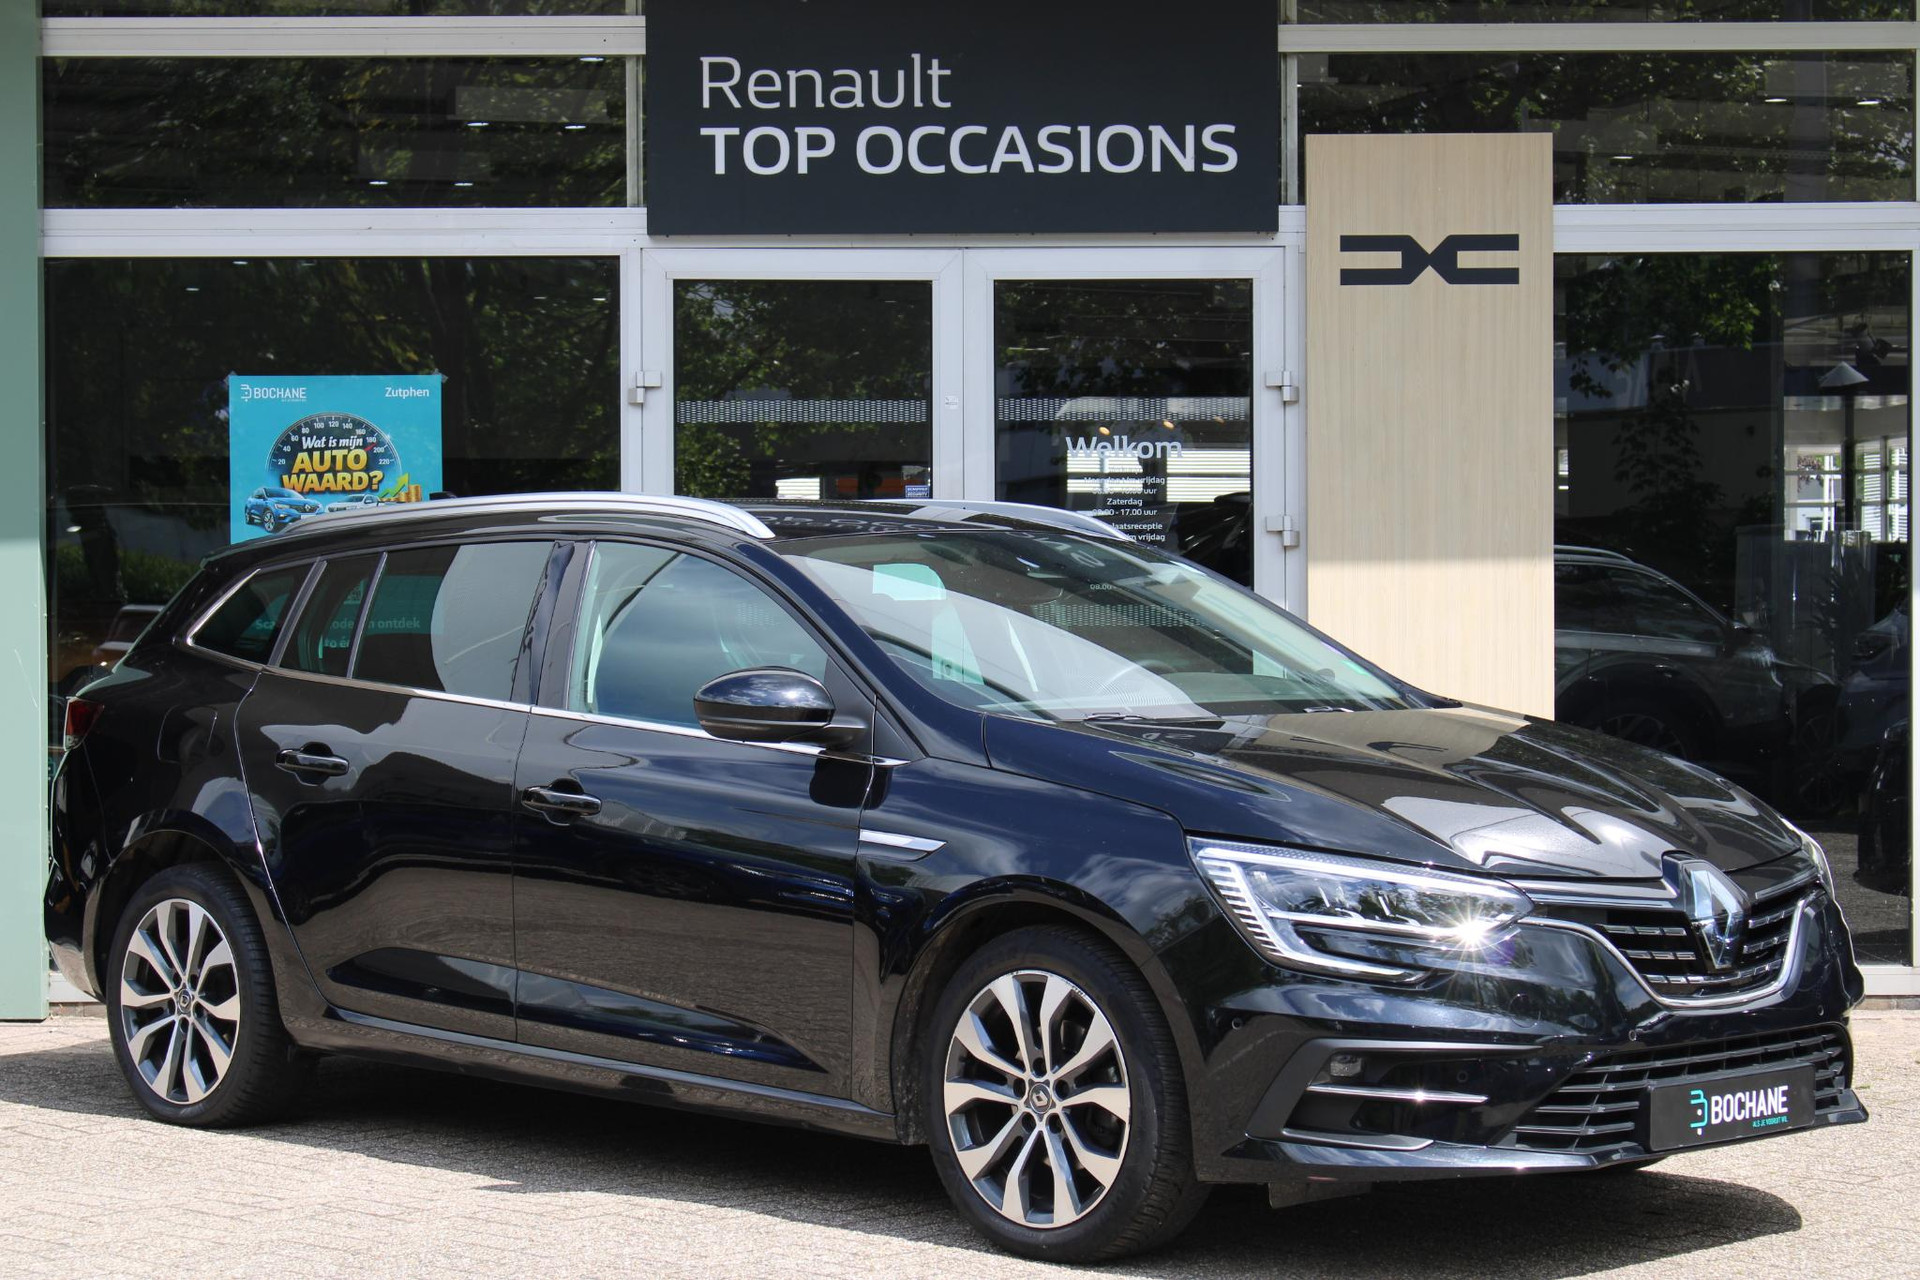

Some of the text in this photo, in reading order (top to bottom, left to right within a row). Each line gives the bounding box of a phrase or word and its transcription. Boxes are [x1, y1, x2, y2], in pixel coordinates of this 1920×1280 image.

[699, 53, 952, 109] Renault
[699, 123, 1239, 175] TOP OCCASIONS
[253, 387, 307, 399] BOCHANE
[385, 386, 430, 399] Zutphen
[342, 422, 353, 430] 140
[301, 436, 363, 450] Wat is mijn
[1065, 435, 1182, 459] Welkom
[291, 450, 368, 474] AUTO
[281, 470, 384, 493] WAARD?
[1138, 477, 1165, 485] vrijdag
[1106, 498, 1143, 506] Zaterdag
[1120, 508, 1142, 516] 17.00
[1112, 522, 1163, 531] laatsreceptie
[1138, 533, 1165, 542] vrijdag
[255, 618, 276, 630] Sca
[377, 616, 421, 629] ontdek
[1711, 1085, 1789, 1125] BOCHANE
